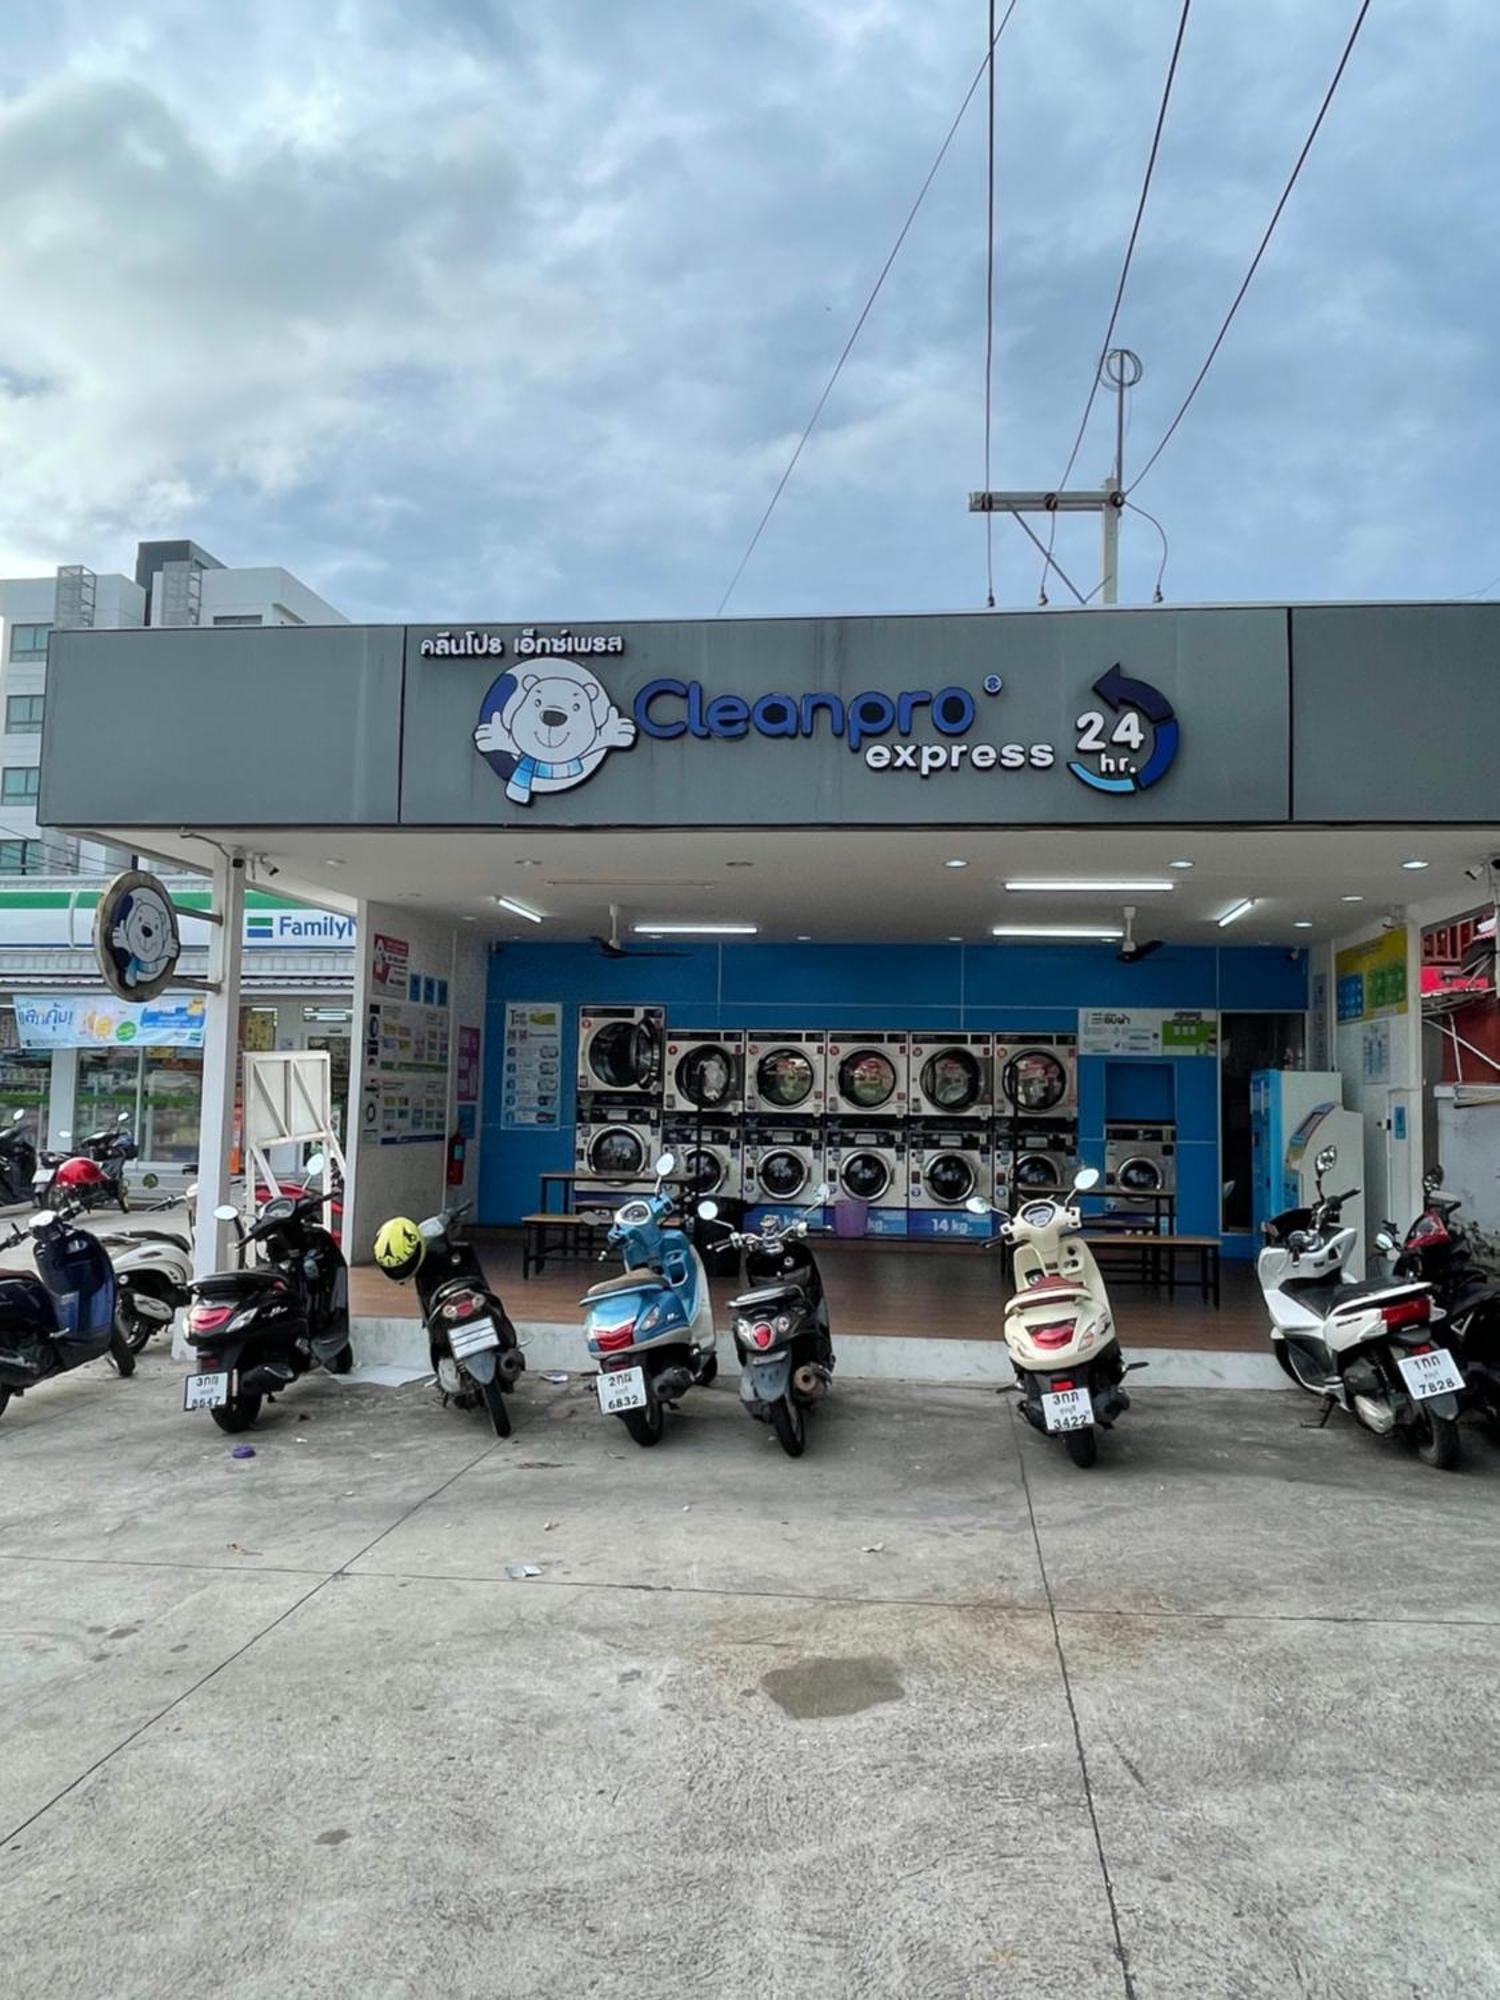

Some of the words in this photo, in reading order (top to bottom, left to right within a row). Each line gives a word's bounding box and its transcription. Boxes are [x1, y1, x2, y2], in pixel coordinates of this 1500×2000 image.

[420, 631, 502, 655] คลีนโปร
[513, 628, 623, 654] เอ็กซ์เพรส
[633, 678, 976, 751] Cleanpro
[1077, 711, 1144, 750] 24
[865, 744, 1055, 777] express
[1100, 753, 1136, 773] hr.
[931, 1218, 949, 1232] 14
[608, 1394, 639, 1410] 6832
